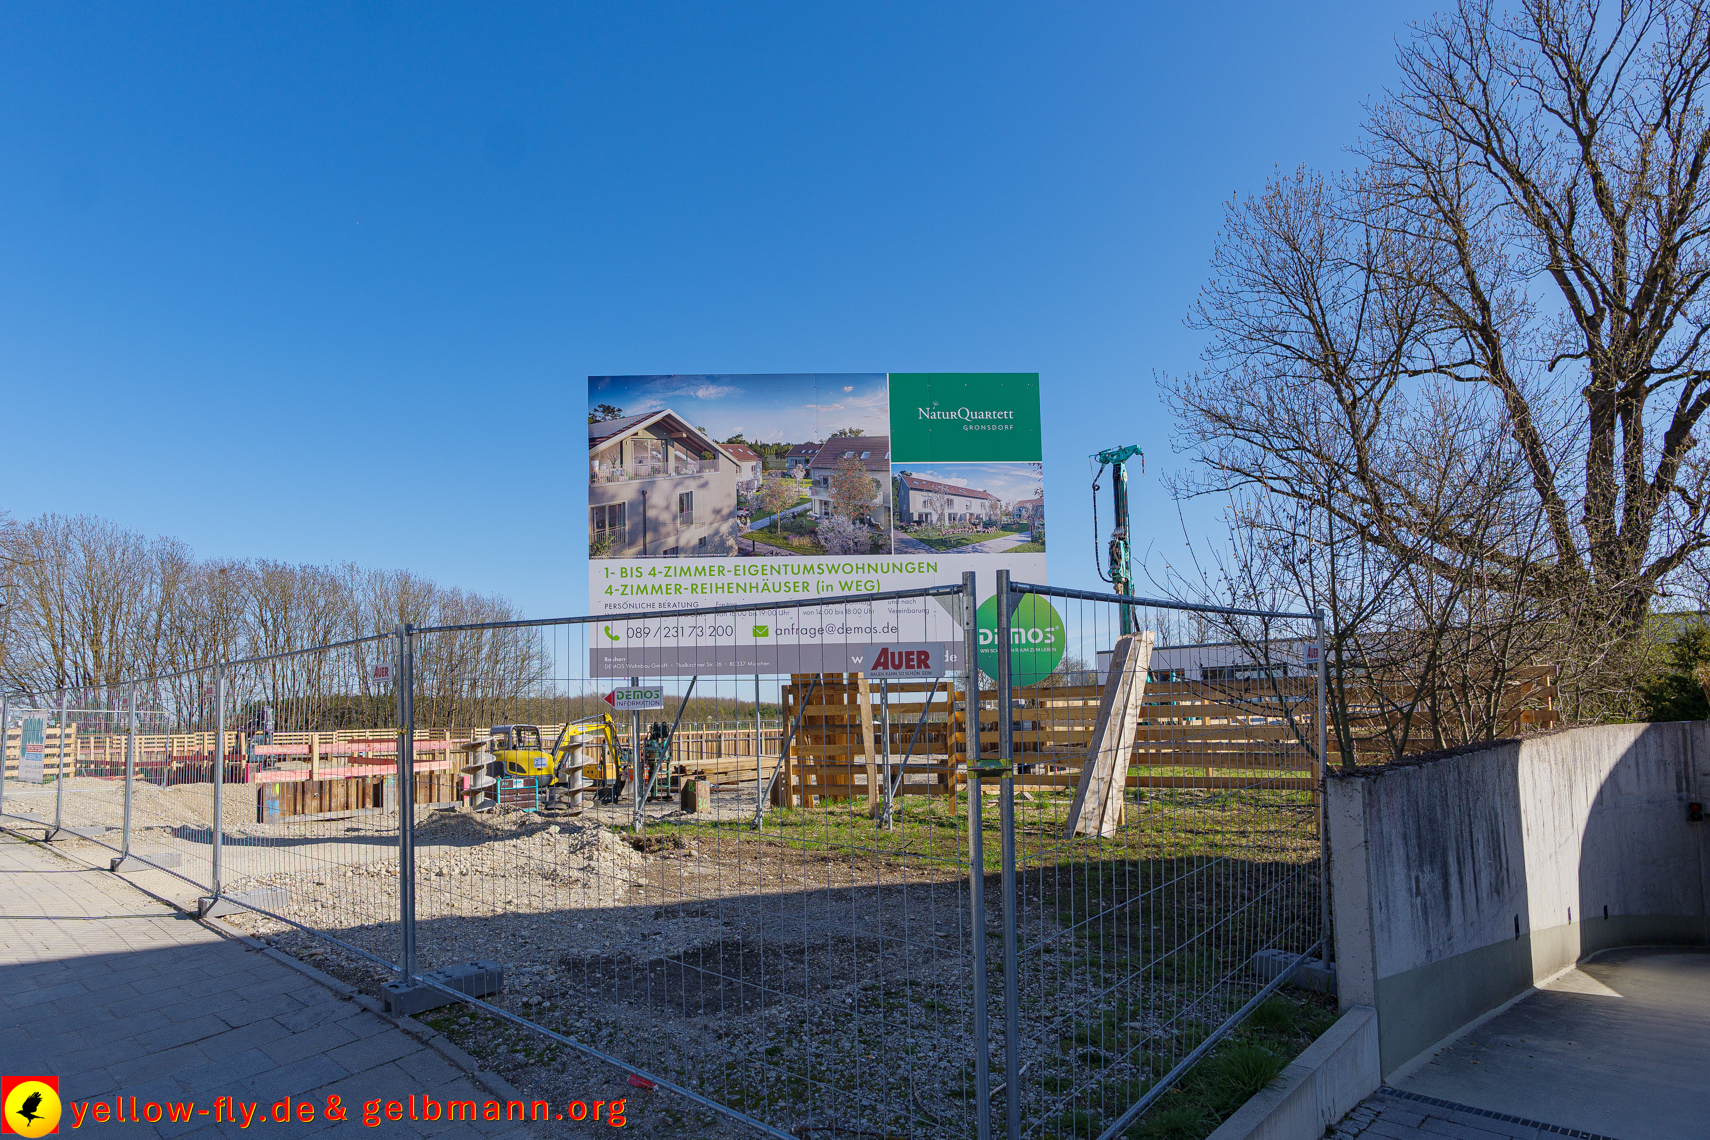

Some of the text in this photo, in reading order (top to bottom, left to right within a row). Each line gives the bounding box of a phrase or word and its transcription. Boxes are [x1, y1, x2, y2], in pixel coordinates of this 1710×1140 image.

[918, 407, 1014, 422] NaturQuartett
[620, 566, 643, 578] BIS
[648, 562, 938, 578] 4-ZIMMER-EIGENTUMSWOHNUNGEN
[604, 579, 880, 596] 4-ZIMMER-REIHENHÄUSER (in WEG)
[627, 627, 651, 638] 089
[708, 625, 733, 637] 200
[775, 622, 898, 638] anfrage@demos.de
[871, 647, 931, 670] AUER
[373, 666, 389, 678] AUER
[616, 690, 660, 700] DEMOS
